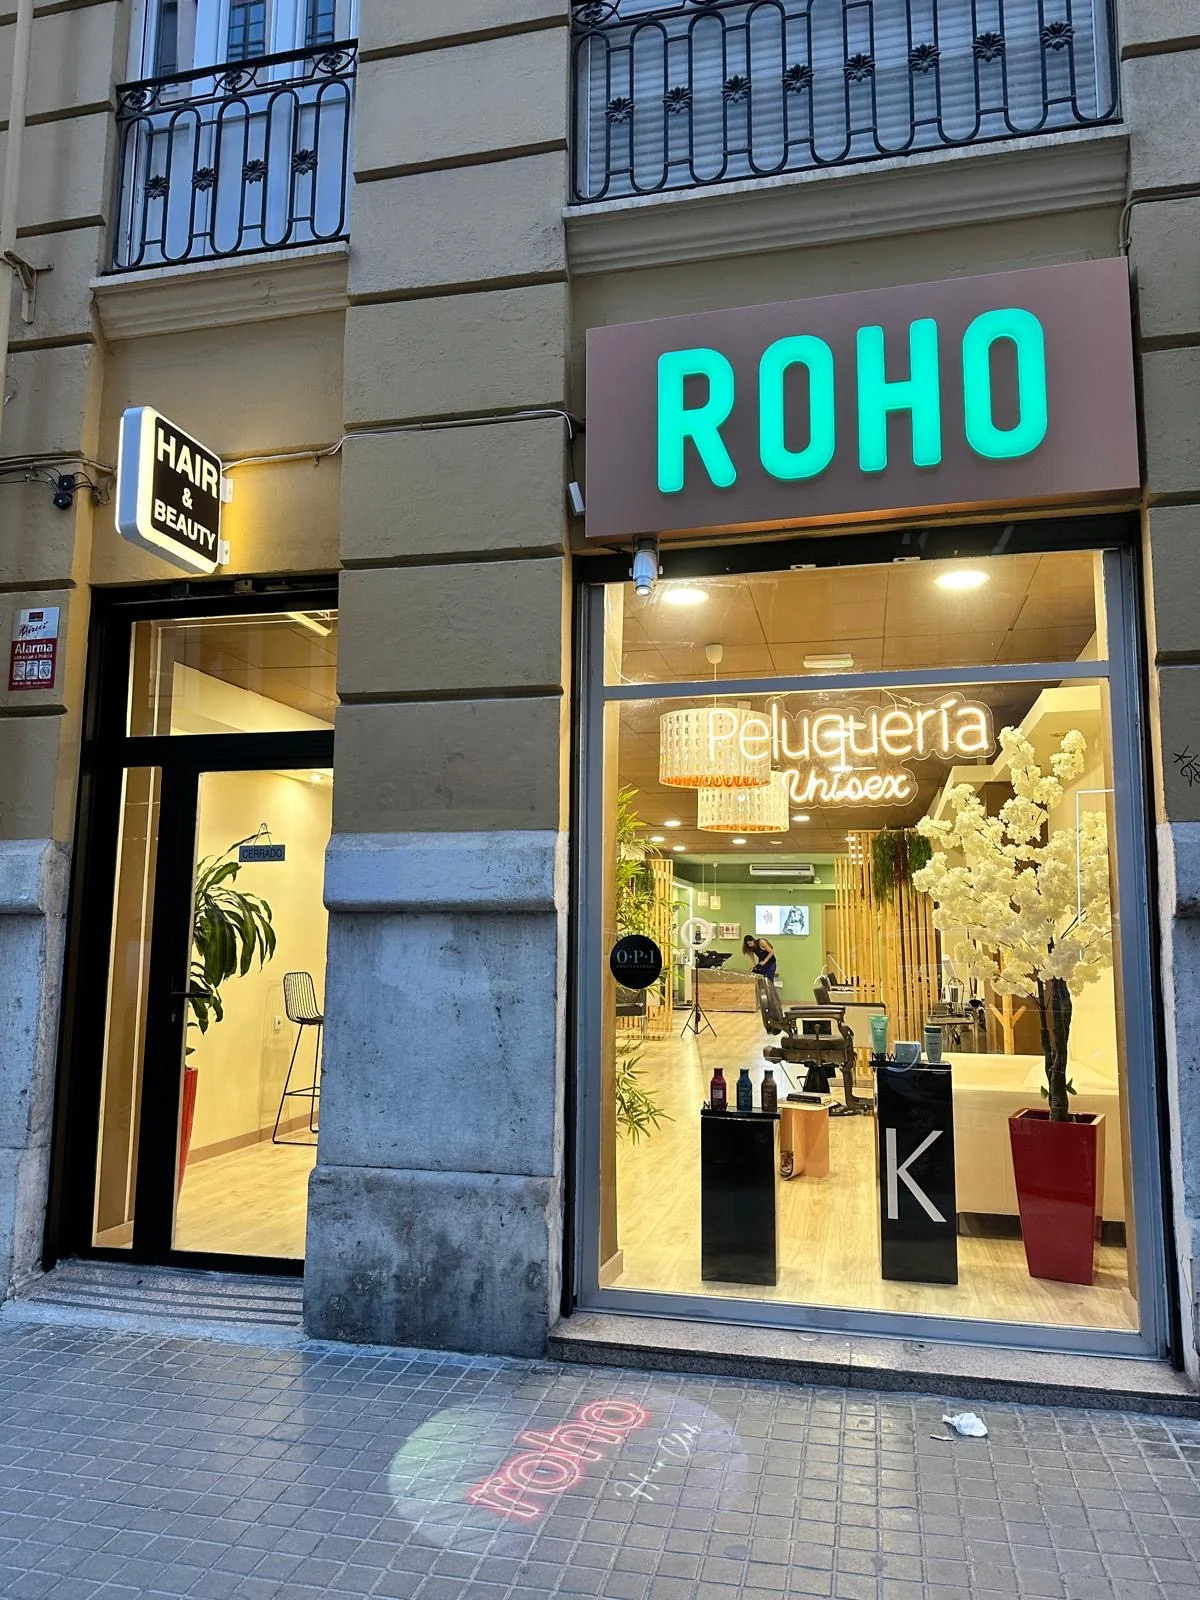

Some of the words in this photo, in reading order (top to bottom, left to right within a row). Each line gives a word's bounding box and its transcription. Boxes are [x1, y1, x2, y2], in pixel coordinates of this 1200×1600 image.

[657, 307, 1048, 493] ROHO
[157, 427, 218, 499] HAIR
[154, 498, 216, 551] BEAUTY
[181, 487, 193, 510] &
[14, 642, 53, 655] Alarma
[708, 698, 989, 772] Peluquería
[781, 767, 911, 802] Unisex
[242, 847, 283, 859] CERRADO
[885, 1127, 948, 1224] K
[469, 1399, 647, 1518] roho
